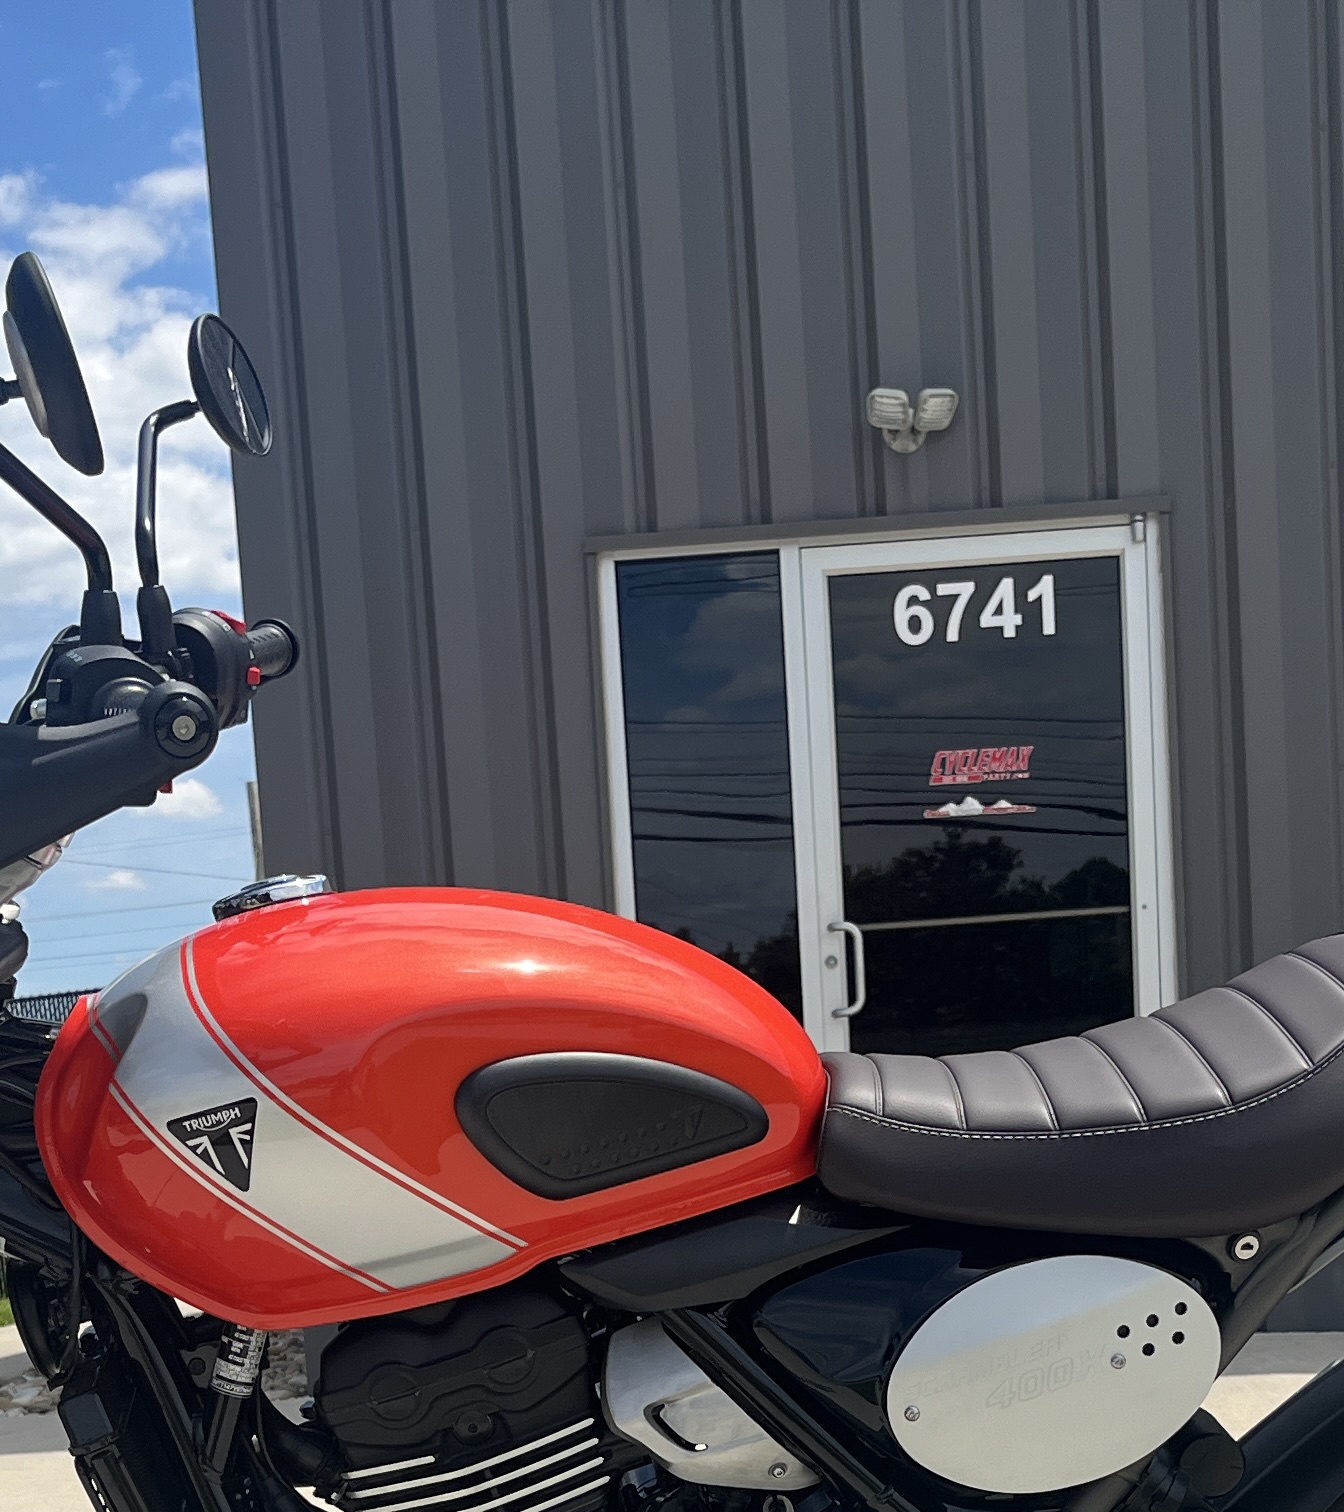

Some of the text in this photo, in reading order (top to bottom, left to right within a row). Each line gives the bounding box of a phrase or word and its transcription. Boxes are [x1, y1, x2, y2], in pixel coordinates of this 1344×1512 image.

[893, 574, 1056, 646] 6741
[931, 746, 1034, 775] CYCLEMAX
[182, 1107, 241, 1132] TRIUMPH
